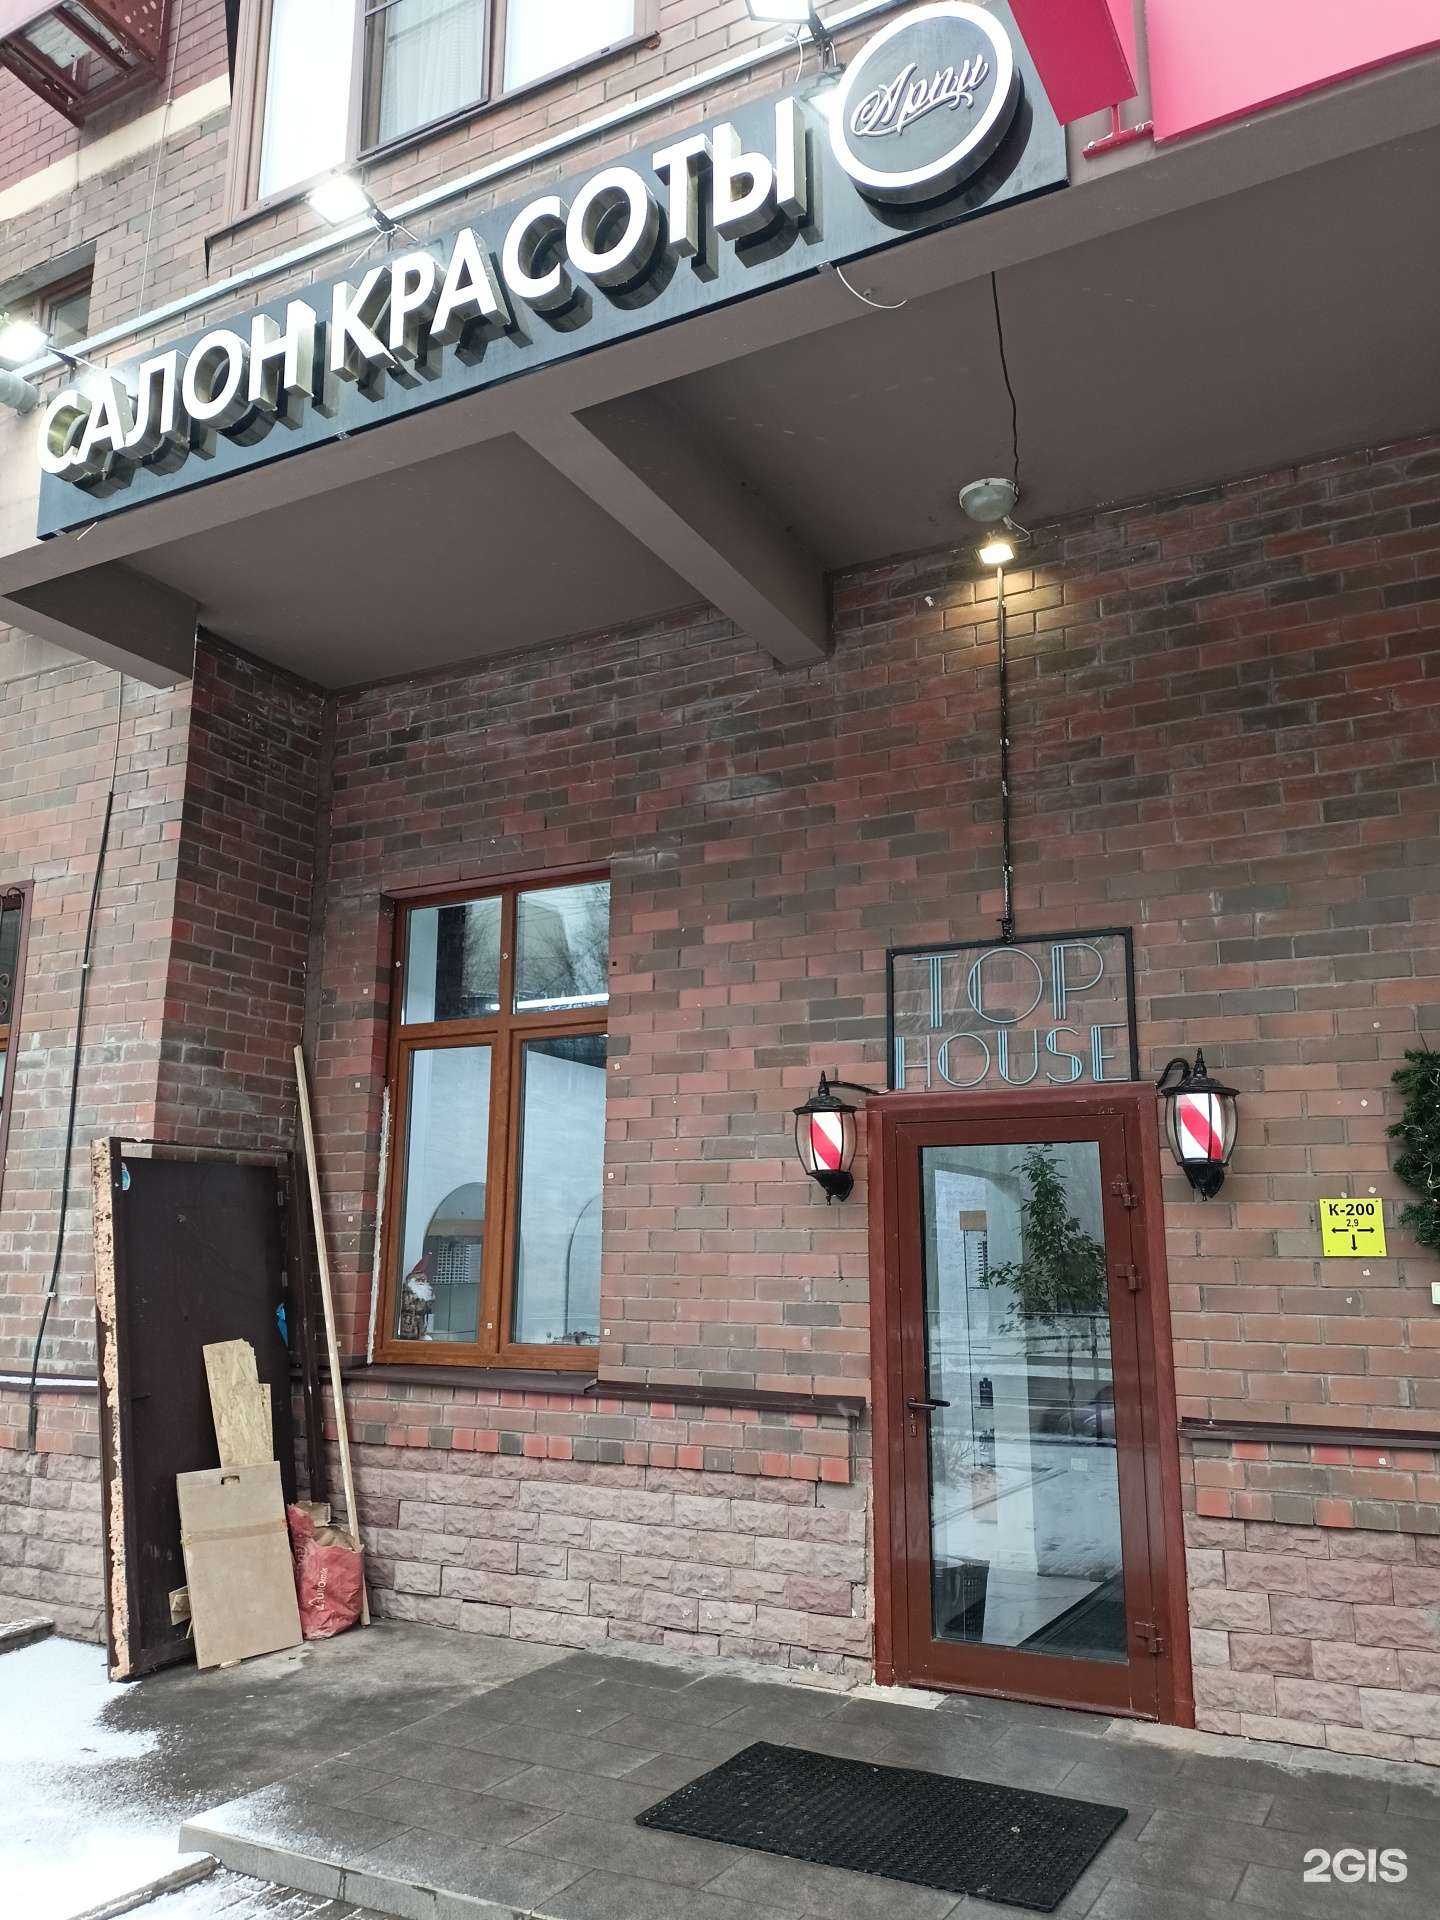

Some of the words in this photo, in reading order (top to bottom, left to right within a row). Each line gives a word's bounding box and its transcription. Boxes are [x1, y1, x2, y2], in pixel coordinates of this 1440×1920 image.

[851, 54, 989, 137] Арпи
[37, 298, 312, 475] САЛОН
[330, 95, 802, 374] КРАСОТЫ
[912, 943, 1104, 1028] TOP
[895, 1024, 1129, 1089] HOUSE
